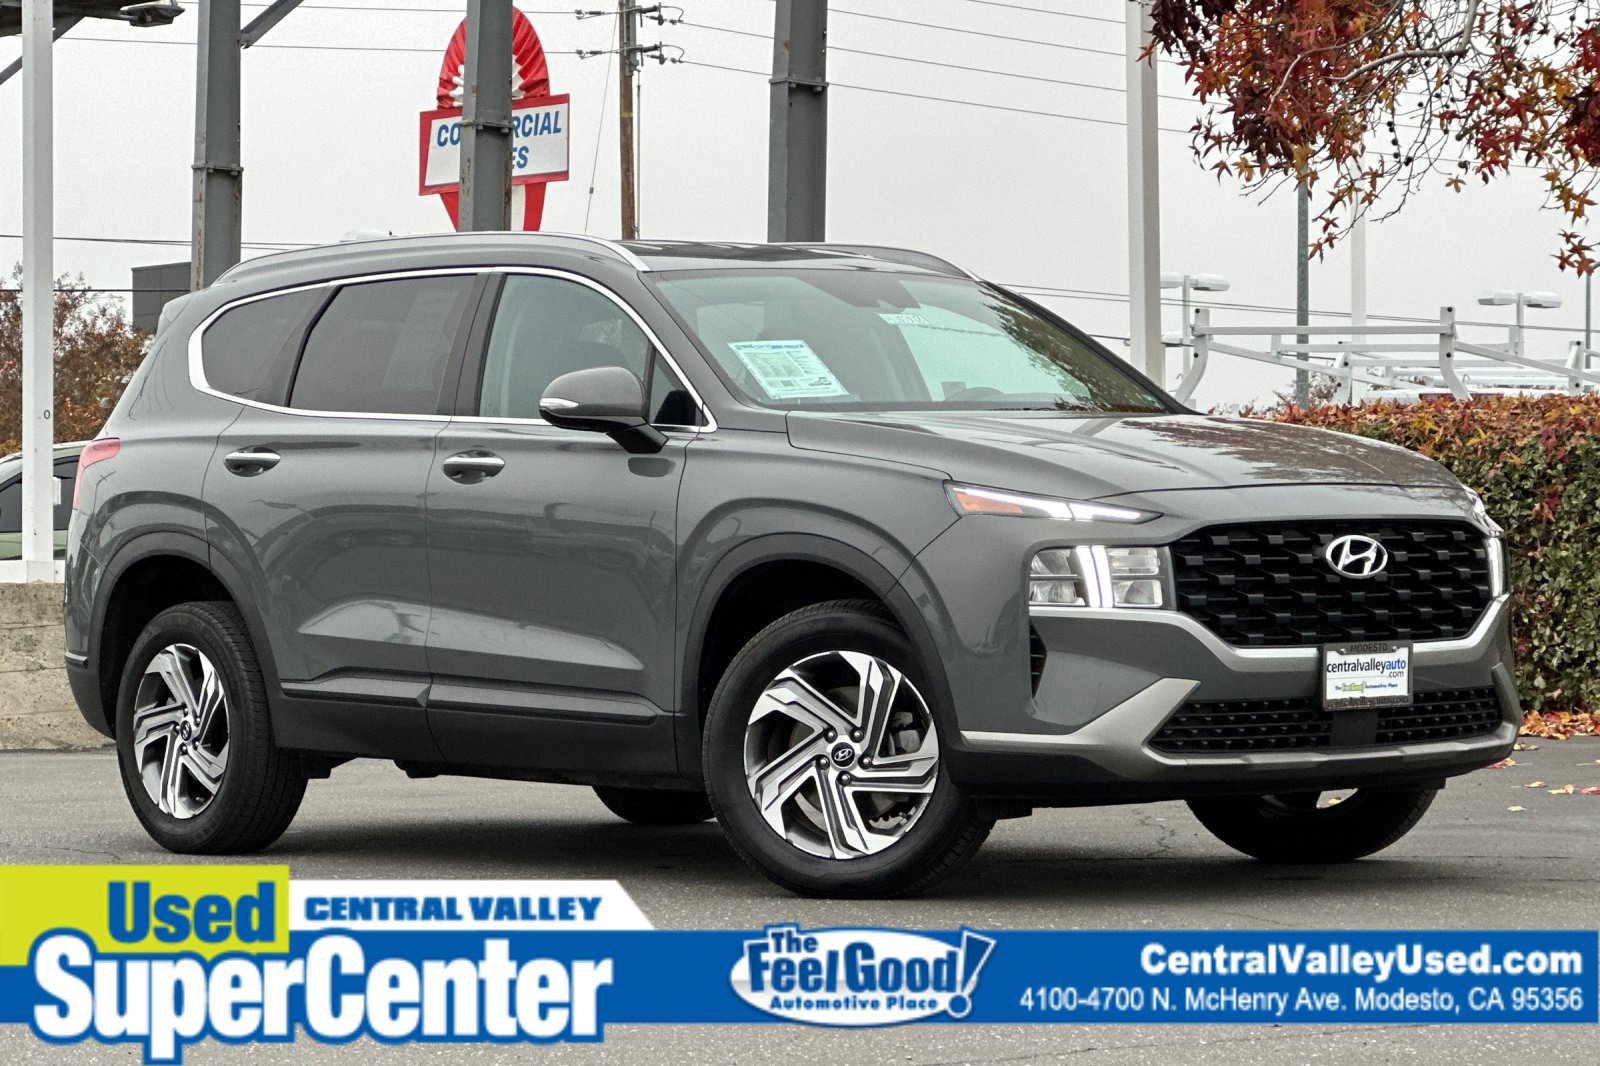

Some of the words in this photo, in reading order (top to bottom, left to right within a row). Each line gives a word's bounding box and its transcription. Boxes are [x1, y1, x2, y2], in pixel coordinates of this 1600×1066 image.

[437, 111, 562, 147] CORCIAL
[1350, 643, 1388, 652] MODESTO
[1326, 658, 1406, 674] centralvalleyauto
